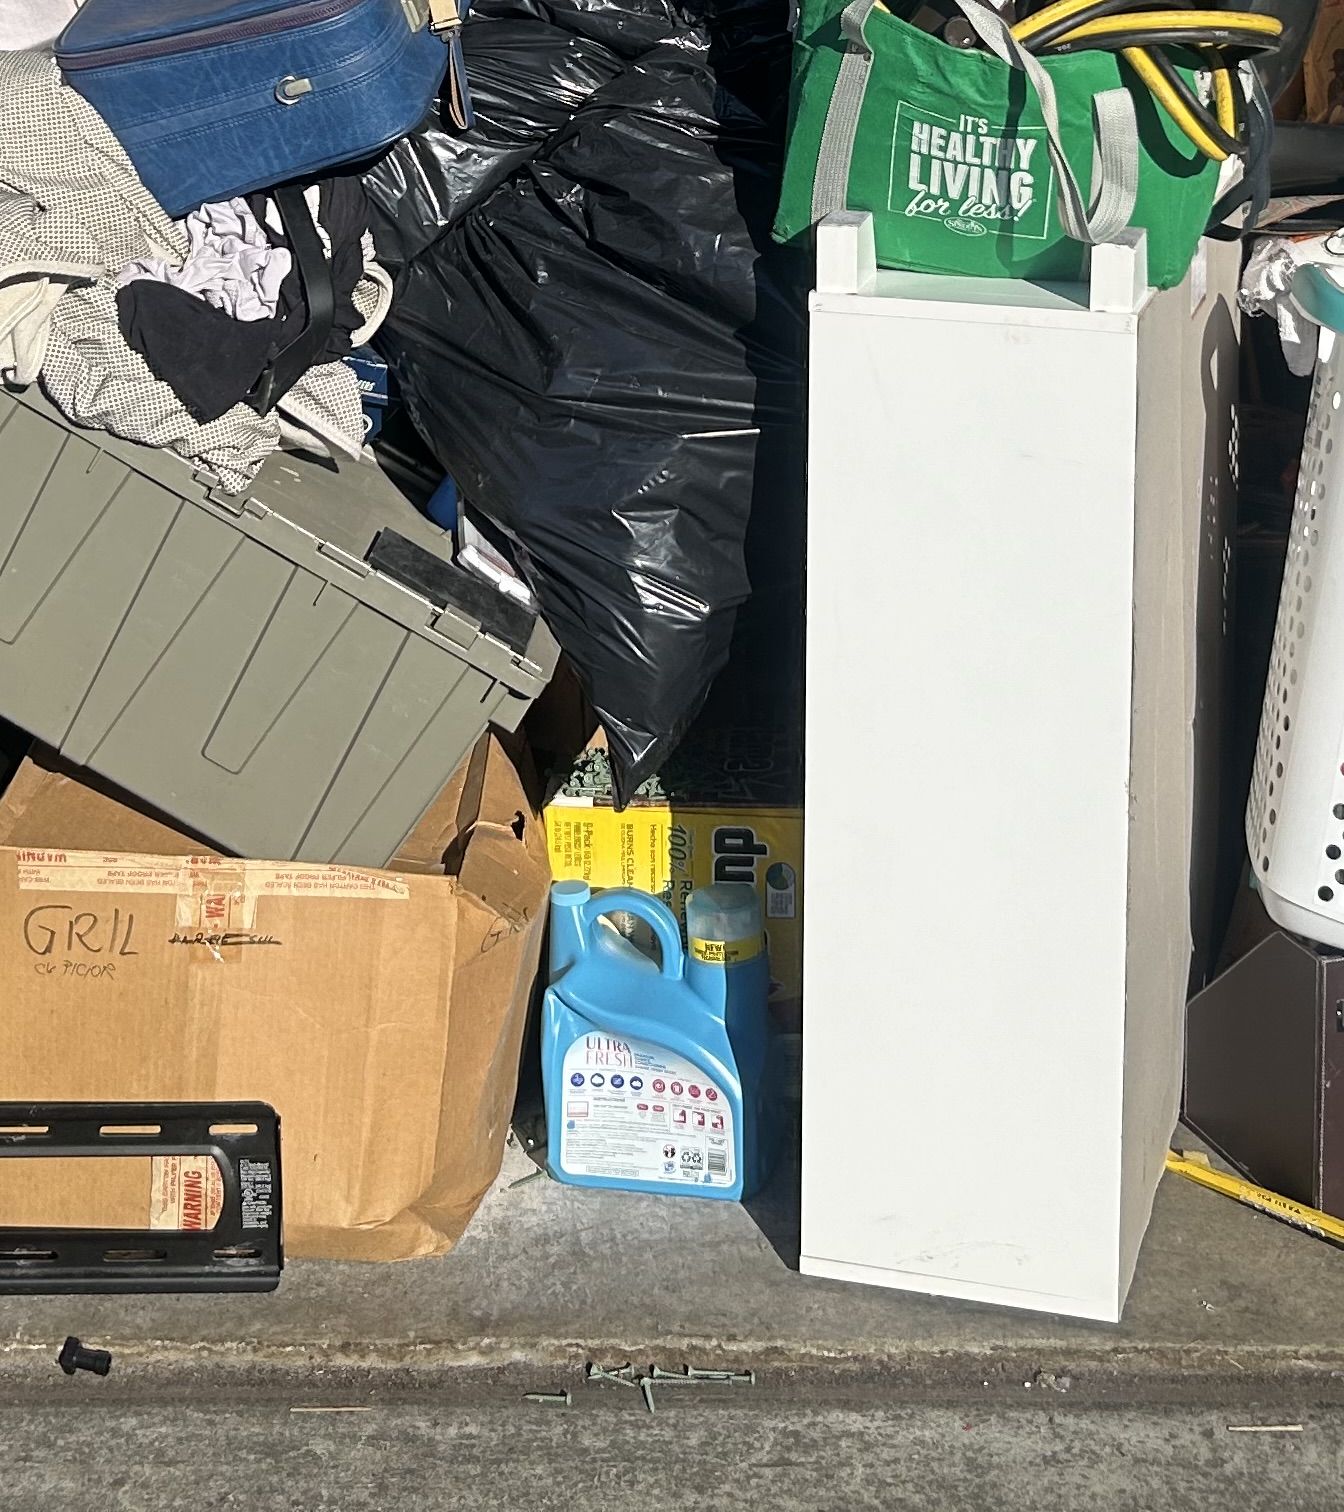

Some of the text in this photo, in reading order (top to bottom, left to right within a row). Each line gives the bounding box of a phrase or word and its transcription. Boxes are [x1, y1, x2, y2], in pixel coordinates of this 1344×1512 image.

[959, 114, 988, 134] IT'S
[911, 120, 1038, 170] HEALTHY
[908, 152, 1034, 210] LIVING
[905, 189, 951, 216] for
[666, 823, 686, 874] 100%
[585, 1035, 632, 1053] ULTRA
[584, 1049, 634, 1068] FRESH
